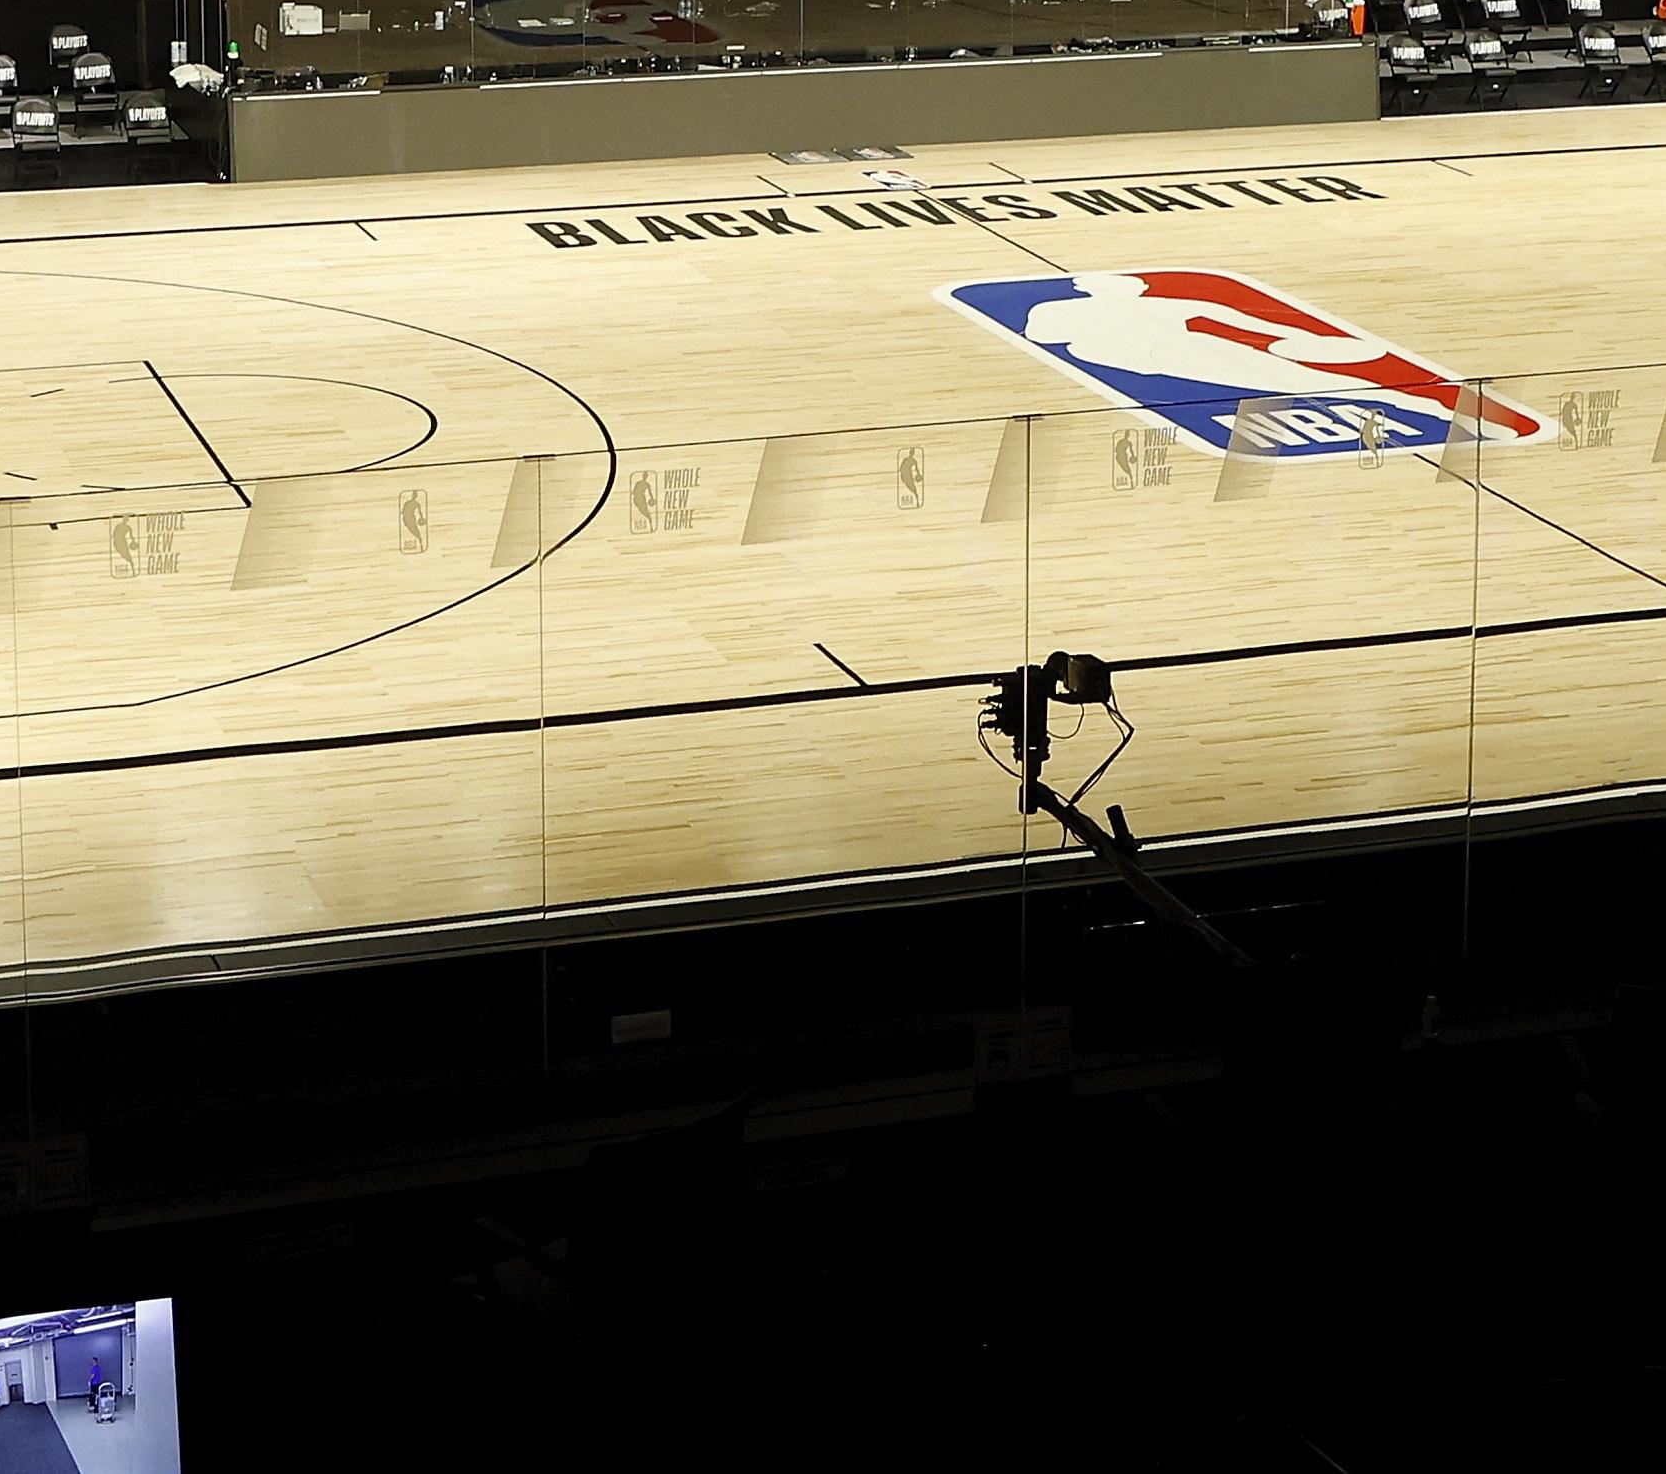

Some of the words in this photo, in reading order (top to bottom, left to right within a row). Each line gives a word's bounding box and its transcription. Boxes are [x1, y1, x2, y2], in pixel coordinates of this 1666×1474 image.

[525, 208, 822, 249] BLACK
[815, 194, 1058, 231] LIVES
[1051, 176, 1388, 216] MATTER
[1144, 426, 1179, 447] WHOLE
[1211, 404, 1424, 449] NBA
[1143, 446, 1168, 467] NEW
[664, 467, 701, 489] WHOLE
[1143, 466, 1173, 487] GAME
[664, 489, 690, 509] NEW
[664, 509, 694, 530] GAME
